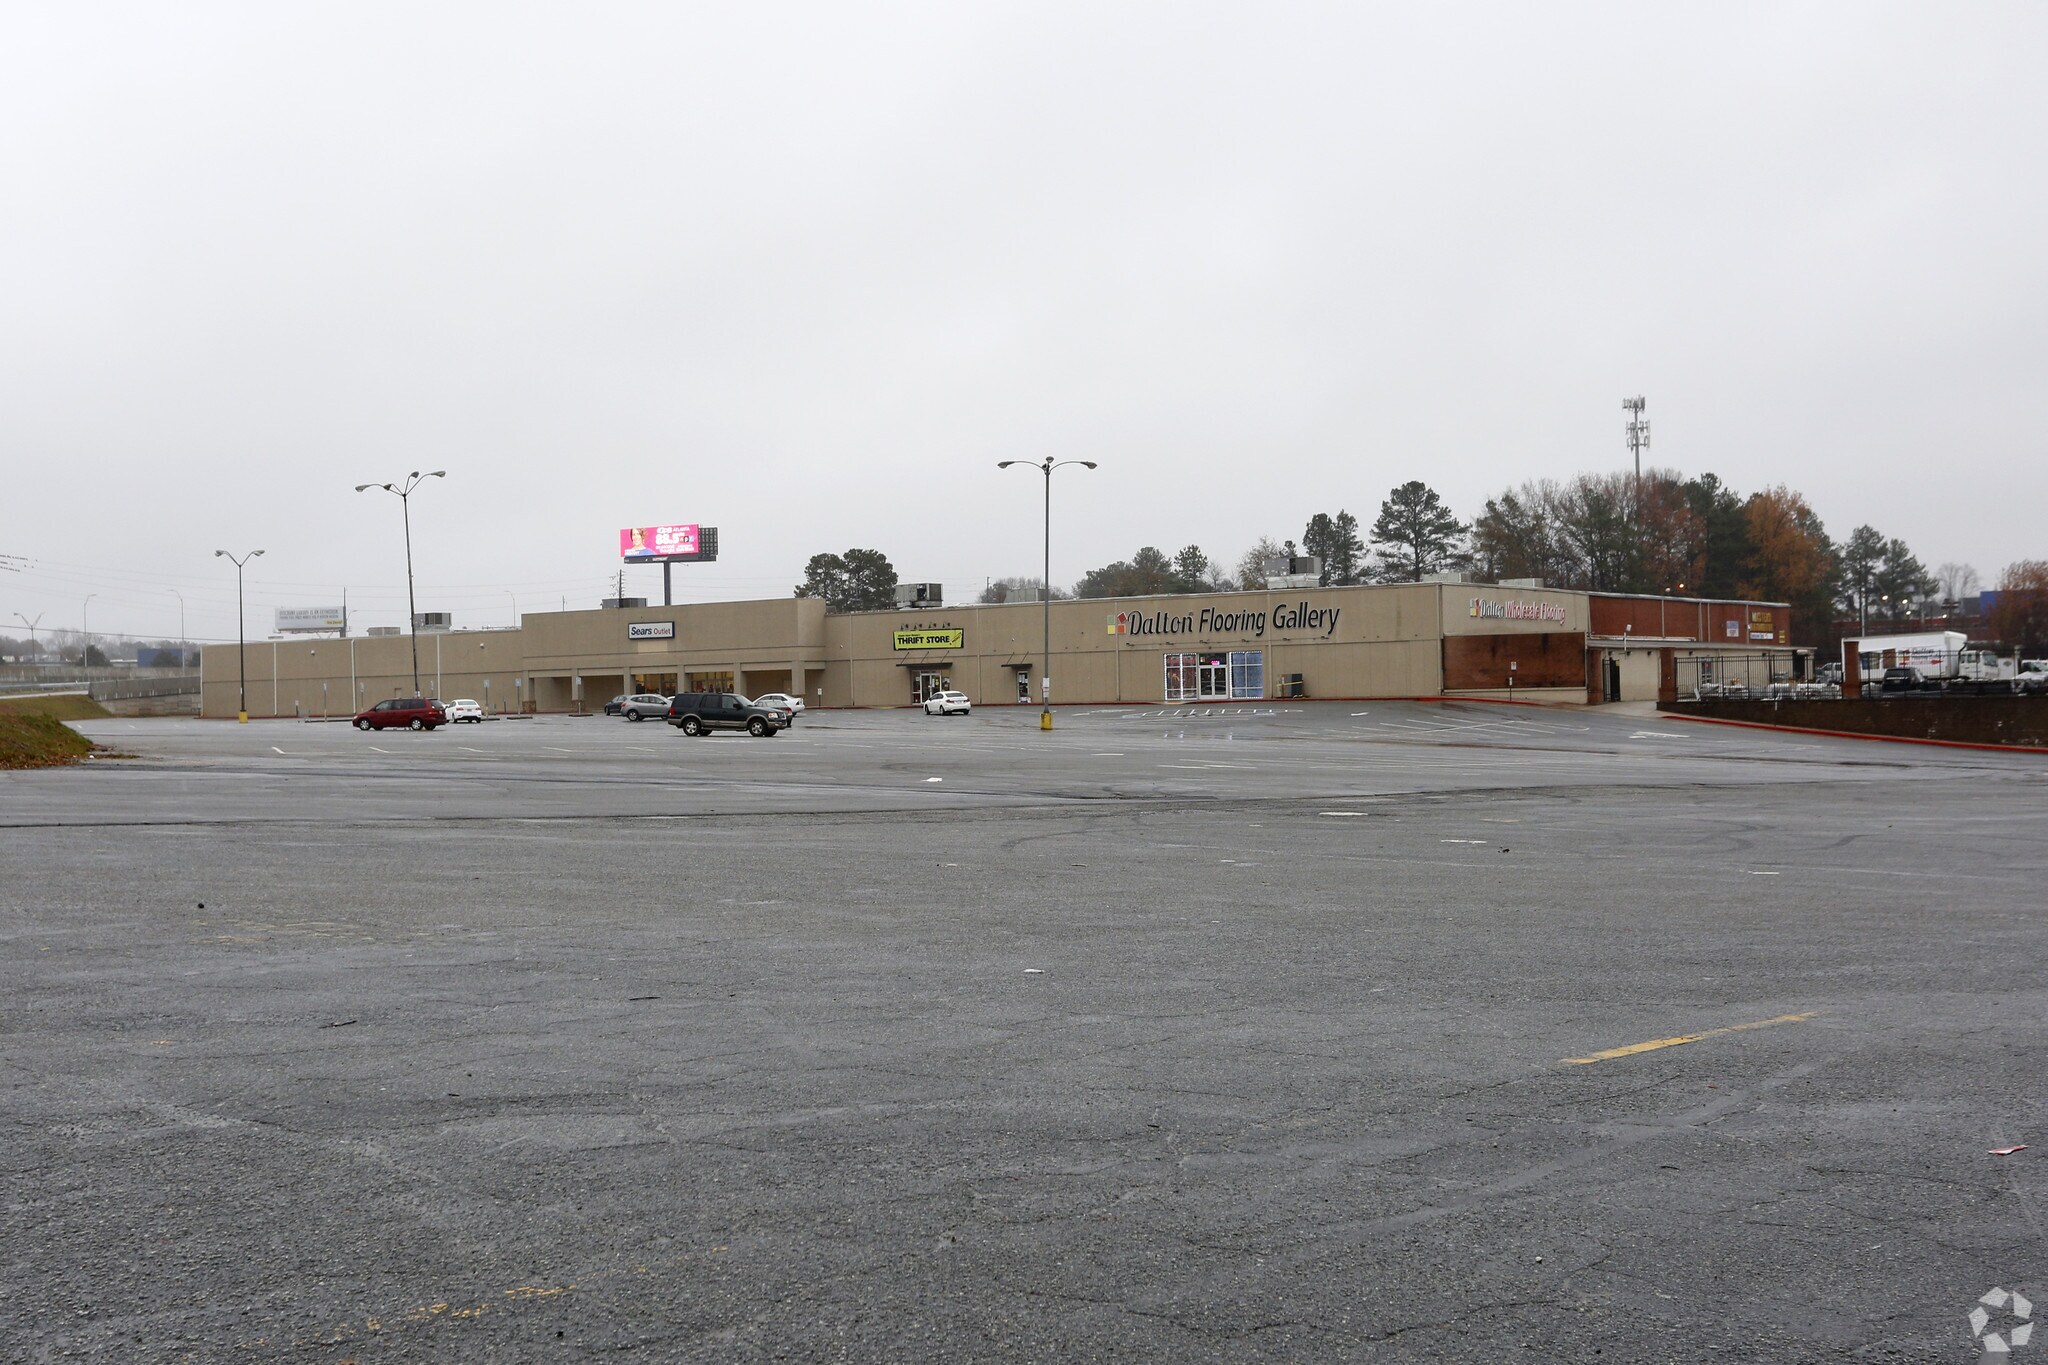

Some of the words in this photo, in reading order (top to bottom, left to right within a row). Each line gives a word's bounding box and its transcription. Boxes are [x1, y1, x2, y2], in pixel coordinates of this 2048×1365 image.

[1127, 610, 1193, 635] Dalton
[1199, 607, 1266, 636] Flooring
[1272, 602, 1340, 634] Gallery
[1505, 600, 1540, 619] Wholesale
[1540, 602, 1565, 625] Flooring
[631, 626, 652, 636] Sears
[653, 627, 671, 635] Outlet
[897, 636, 924, 645] THRIFT
[926, 635, 950, 644] STORE
